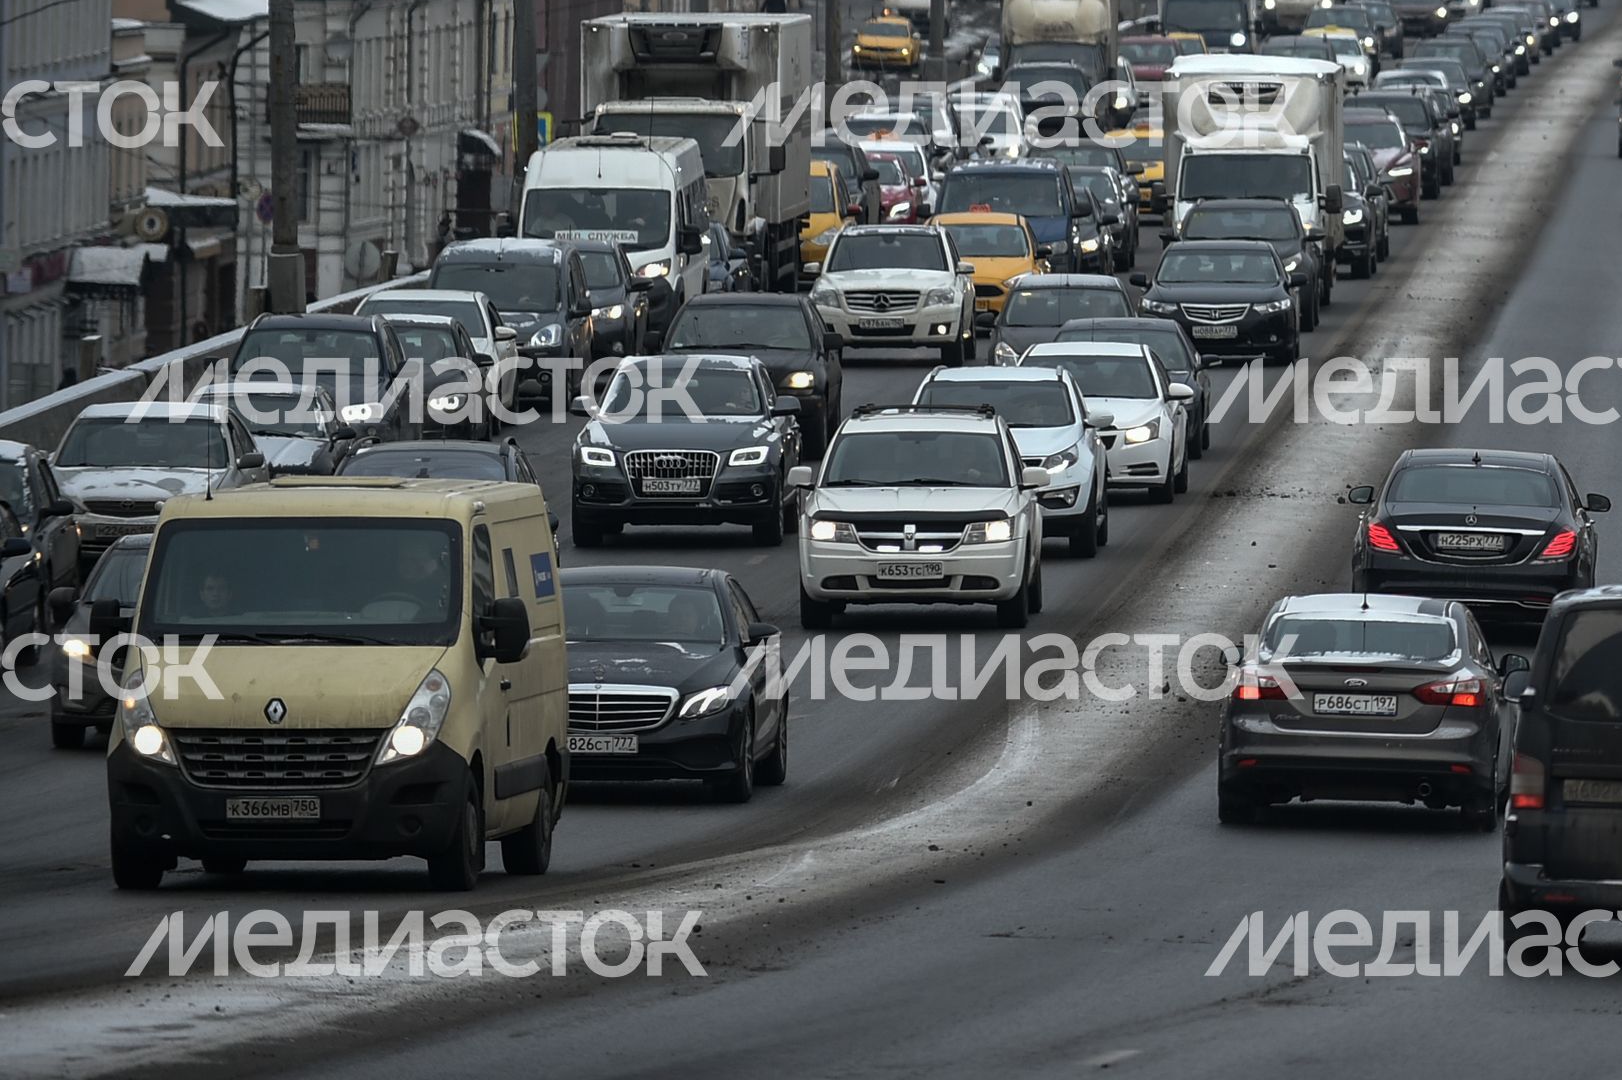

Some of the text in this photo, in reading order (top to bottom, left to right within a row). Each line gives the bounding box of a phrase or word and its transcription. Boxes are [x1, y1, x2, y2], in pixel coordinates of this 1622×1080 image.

[1441, 534, 1500, 546] Н225РХ 777
[881, 563, 941, 575] К653ТС 190
[1318, 695, 1393, 711] Р686СТ 197
[568, 736, 633, 751] 826СТ 777
[231, 799, 316, 817] К366МВ 750
